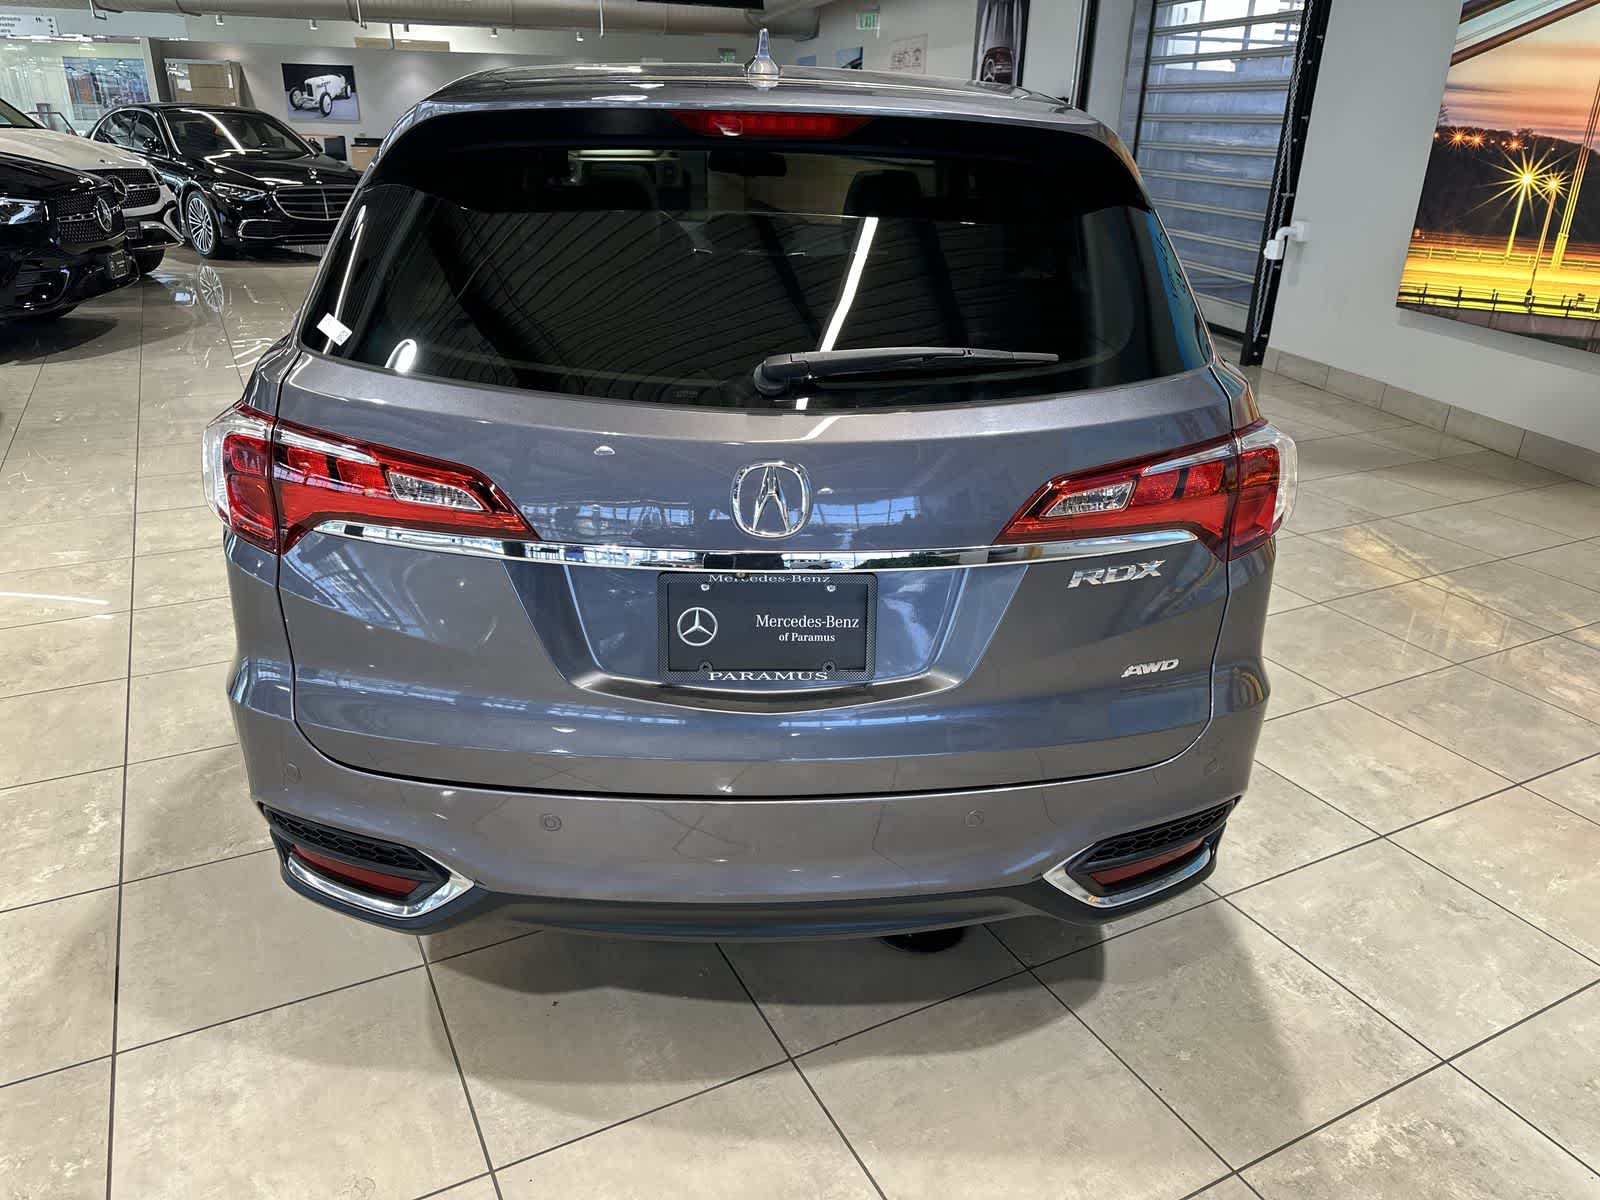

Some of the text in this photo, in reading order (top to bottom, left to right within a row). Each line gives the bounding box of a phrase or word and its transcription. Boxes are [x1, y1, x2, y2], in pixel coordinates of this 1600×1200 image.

[1067, 559, 1166, 588] RDX
[755, 614, 860, 629] Mercedes-Benz
[778, 632, 836, 643] of Paramus
[1121, 658, 1180, 678] AWD
[708, 672, 829, 681] PARAMUS
